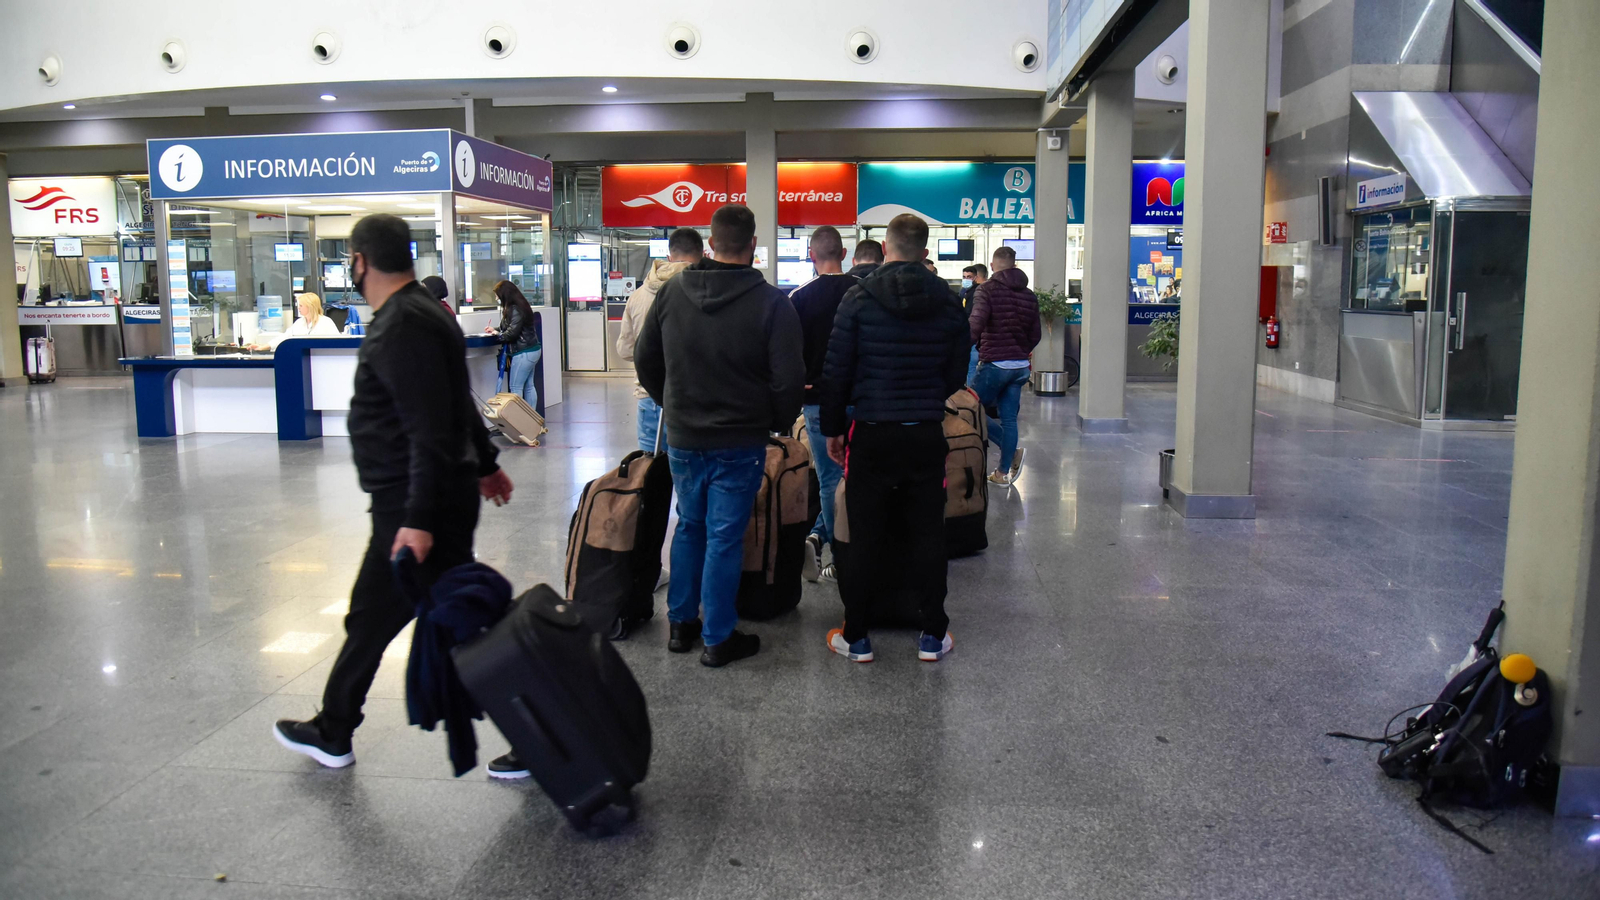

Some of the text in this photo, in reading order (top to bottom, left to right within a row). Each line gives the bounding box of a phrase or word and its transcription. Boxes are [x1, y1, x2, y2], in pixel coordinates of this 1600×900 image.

[224, 151, 376, 179] INFORMACIÓN
[393, 165, 428, 174] Algeciras
[480, 162, 535, 191] INFORMACIÓN
[1367, 182, 1404, 199] información
[54, 207, 100, 224] FRS
